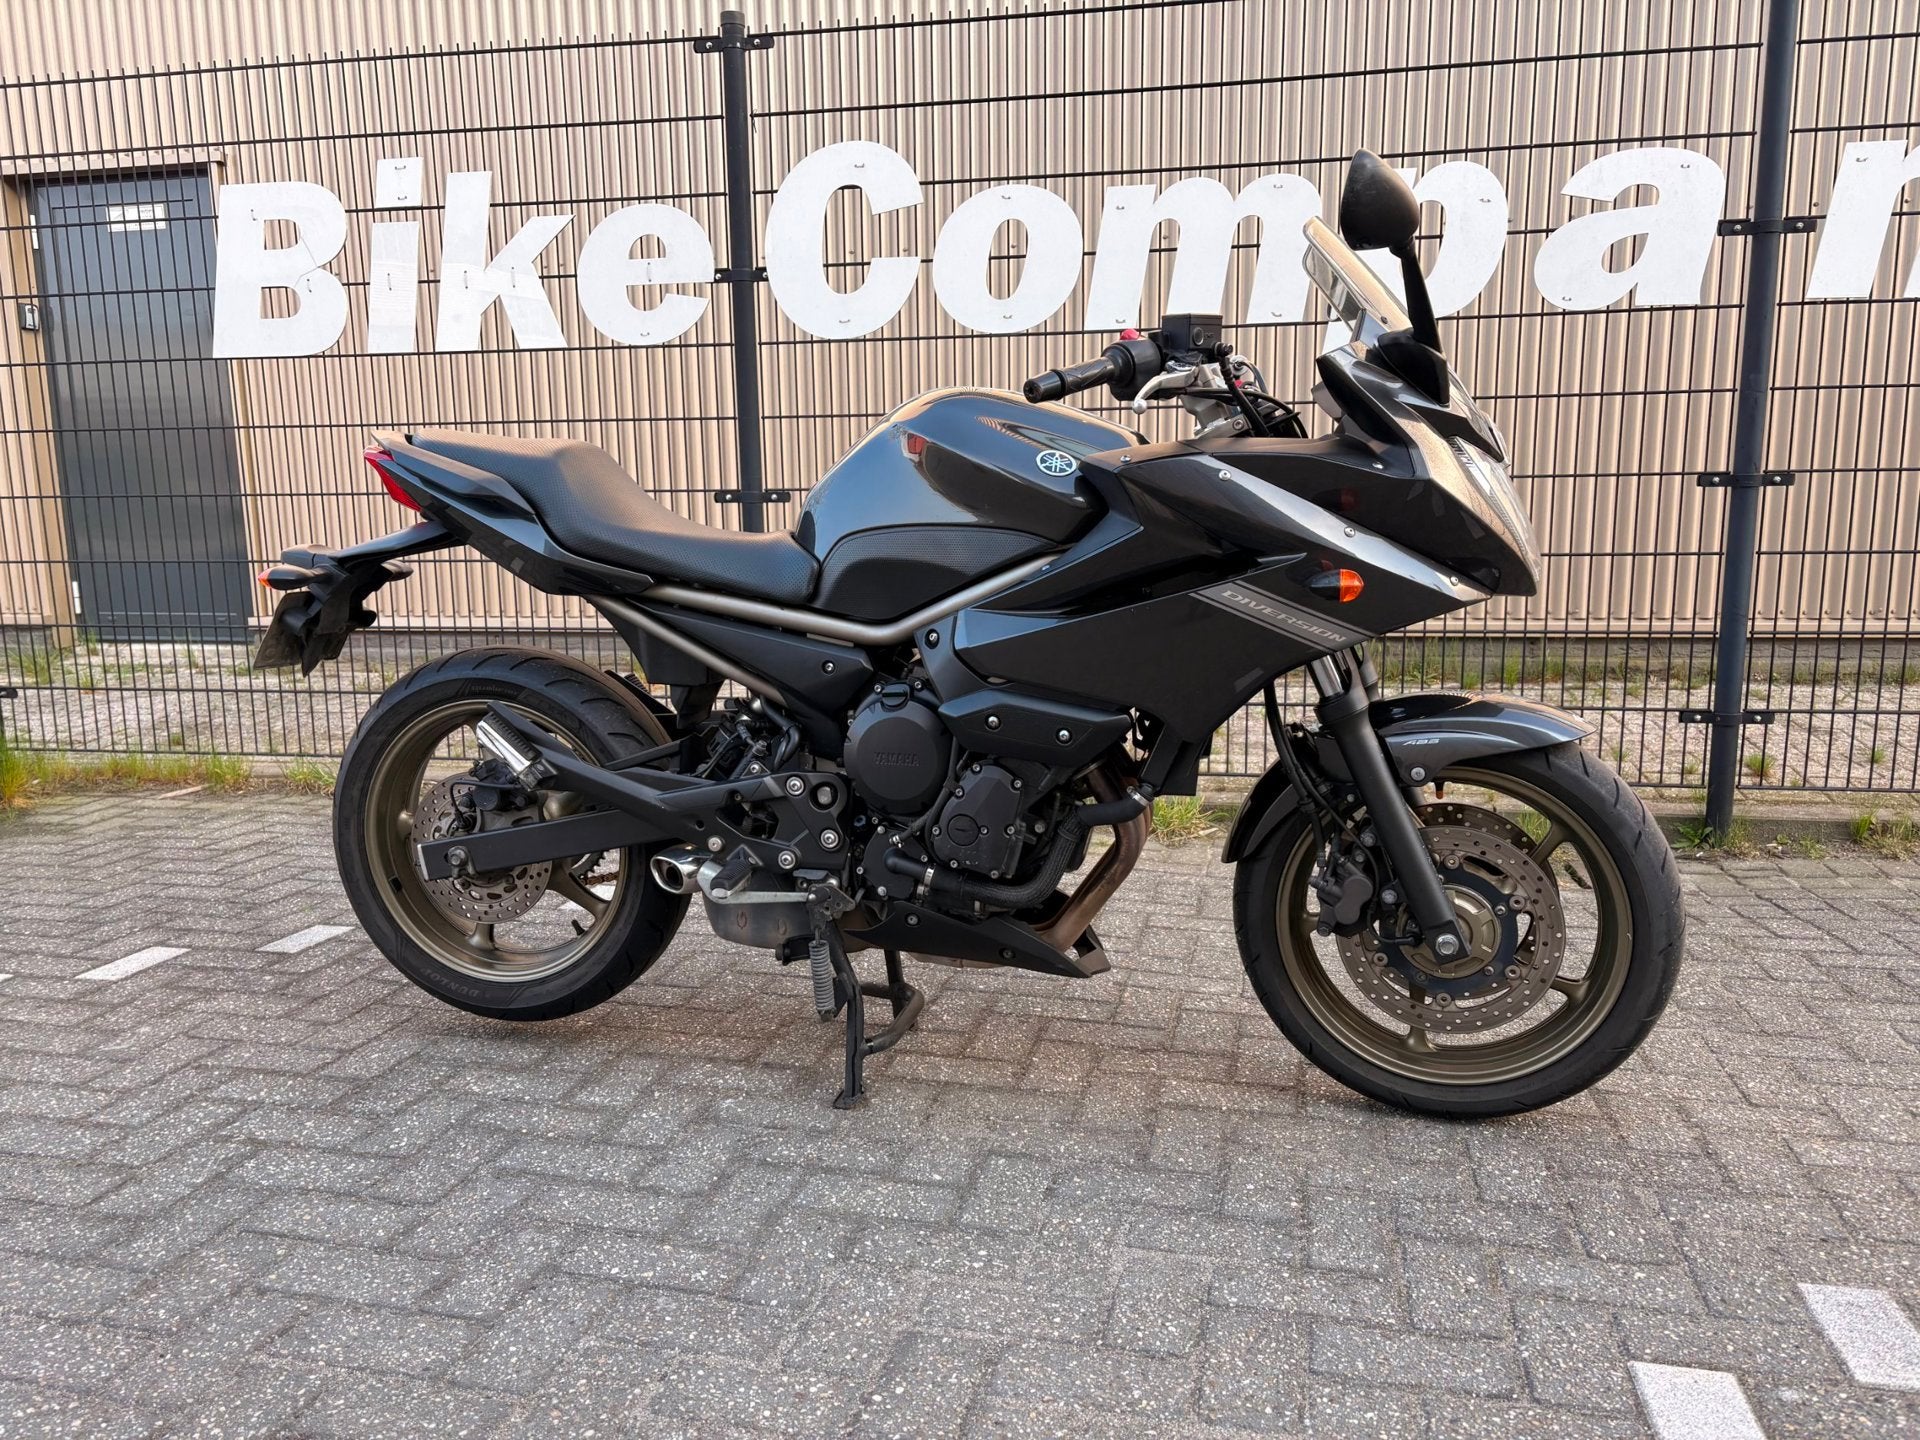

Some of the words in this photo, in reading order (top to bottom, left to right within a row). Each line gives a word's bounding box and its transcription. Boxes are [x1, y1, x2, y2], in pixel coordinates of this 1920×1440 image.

[1220, 589, 1347, 643] DIVERSION
[1402, 738, 1441, 746] ABS
[872, 751, 921, 767] YAMAHA
[420, 967, 481, 998] DUNLOP
